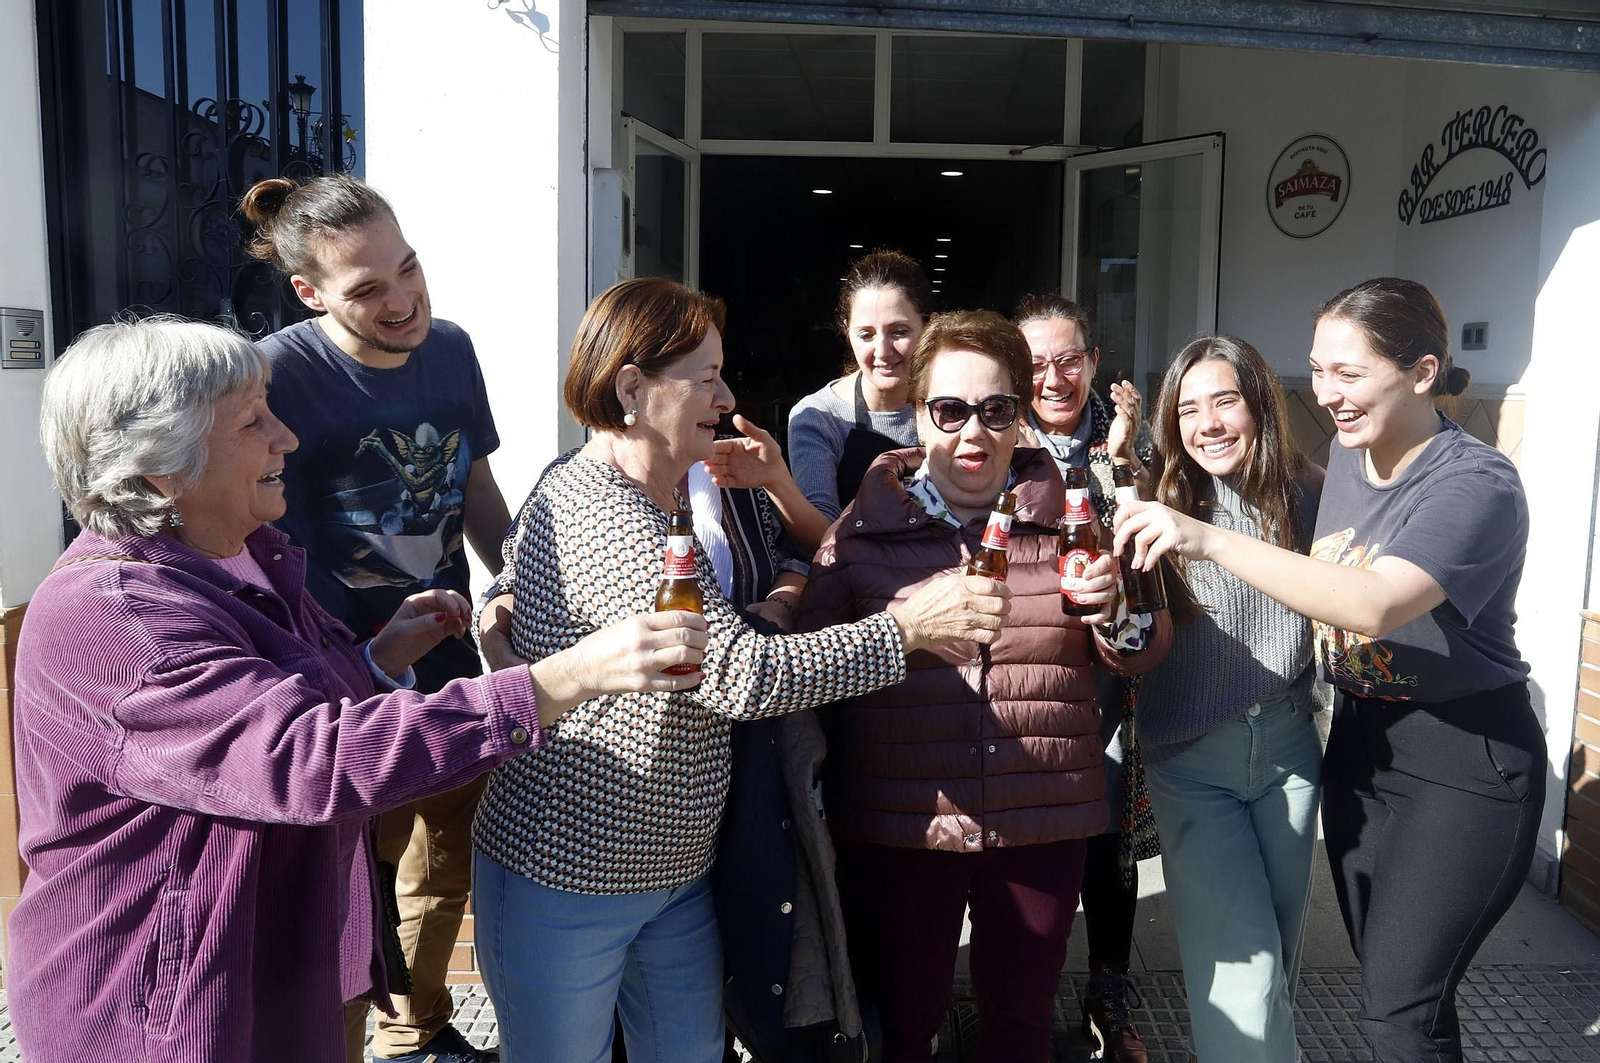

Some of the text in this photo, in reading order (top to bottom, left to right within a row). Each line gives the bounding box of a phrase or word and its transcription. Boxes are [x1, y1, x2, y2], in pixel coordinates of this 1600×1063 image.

[1289, 145, 1315, 160] DISFRUTA
[1398, 104, 1548, 226] BAR TERCERO
[1277, 176, 1337, 198] SAIMAZA
[1419, 172, 1514, 224] DESDE 1948
[1293, 209, 1317, 220] CAFÉ
